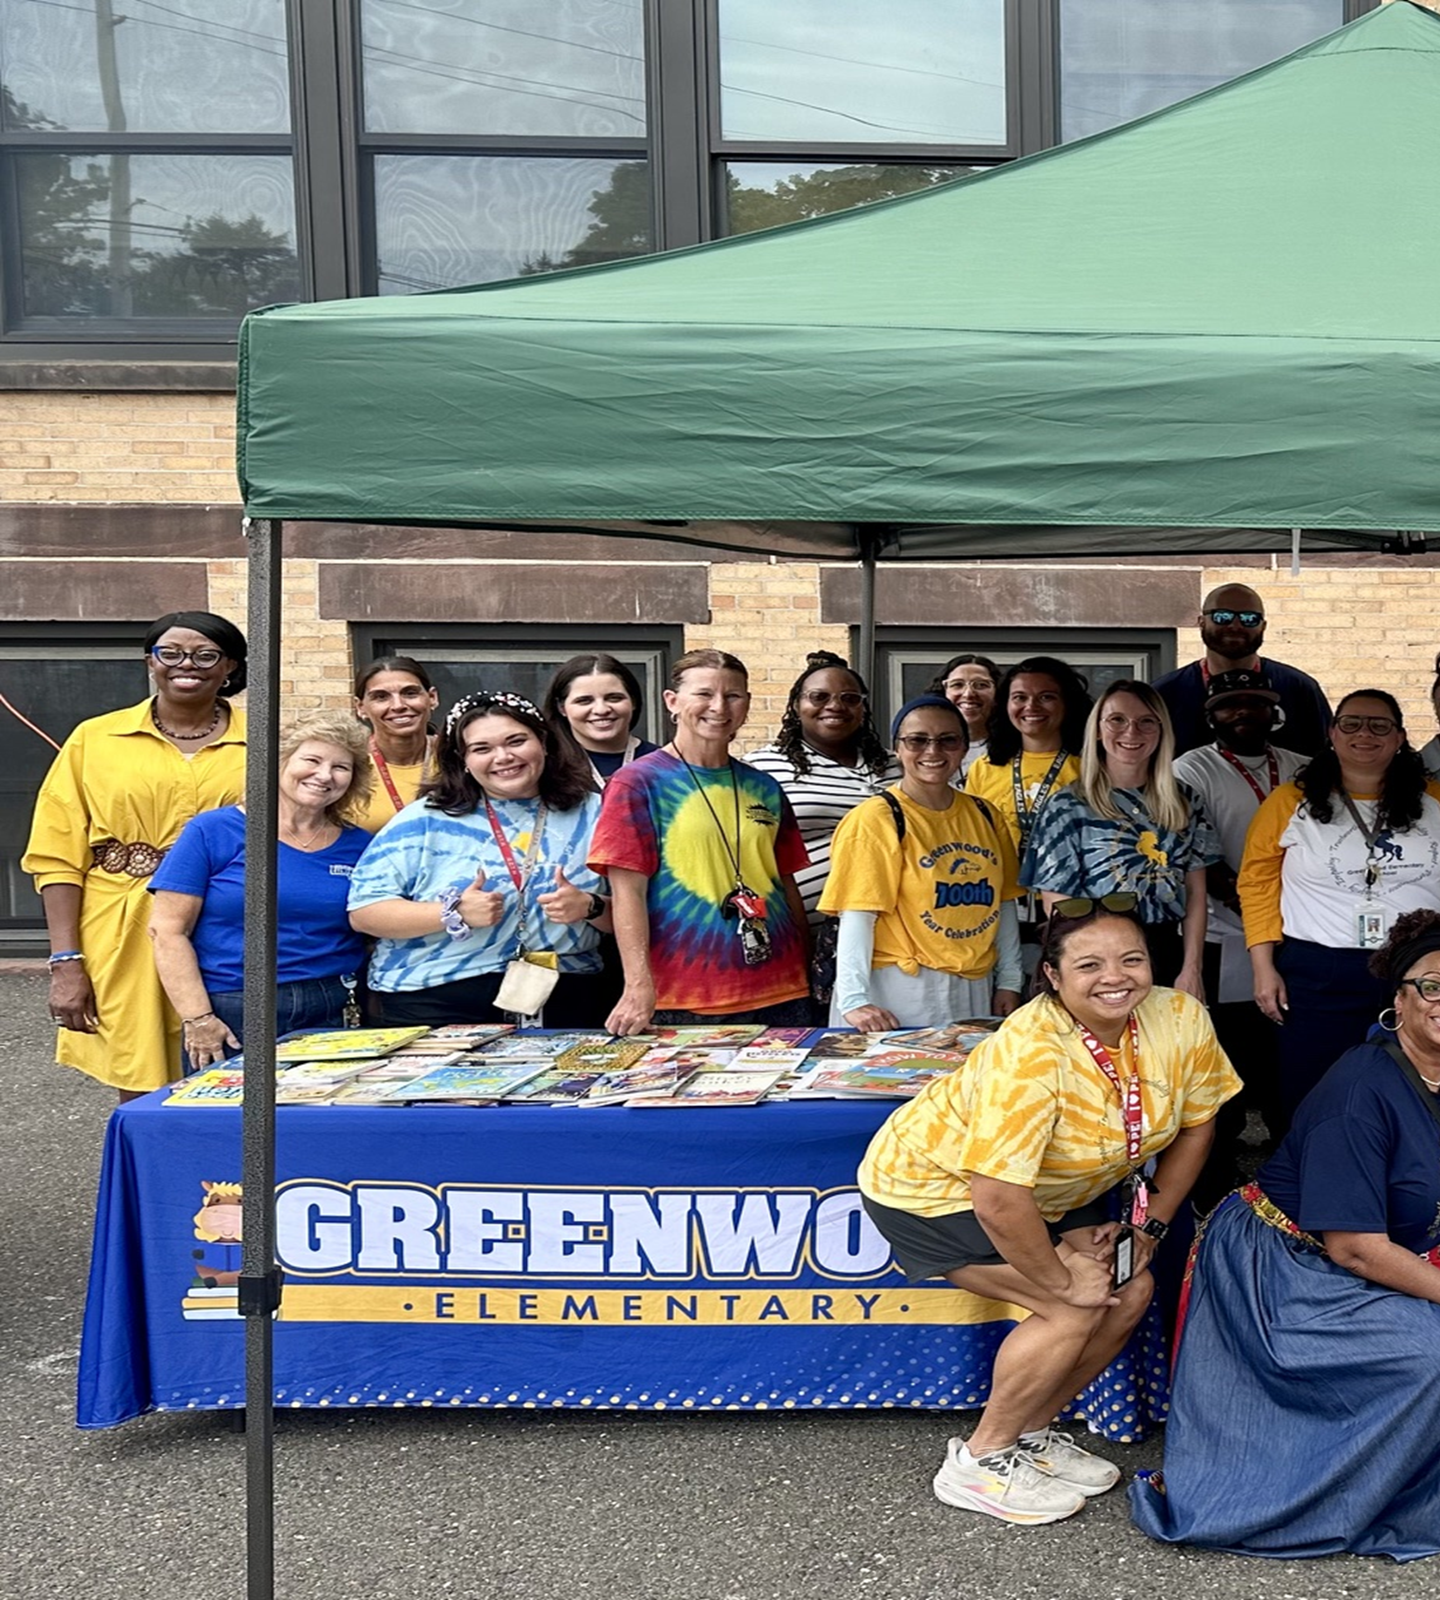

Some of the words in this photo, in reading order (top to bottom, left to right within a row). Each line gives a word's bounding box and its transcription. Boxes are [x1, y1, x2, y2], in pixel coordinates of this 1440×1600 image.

[919, 841, 999, 869] Greenwood's
[934, 877, 995, 910] 100th
[919, 910, 944, 934] Year
[944, 909, 1000, 939] Celebration
[275, 1183, 892, 1276] GREENWO
[436, 1292, 881, 1321] ELEMENTARY
